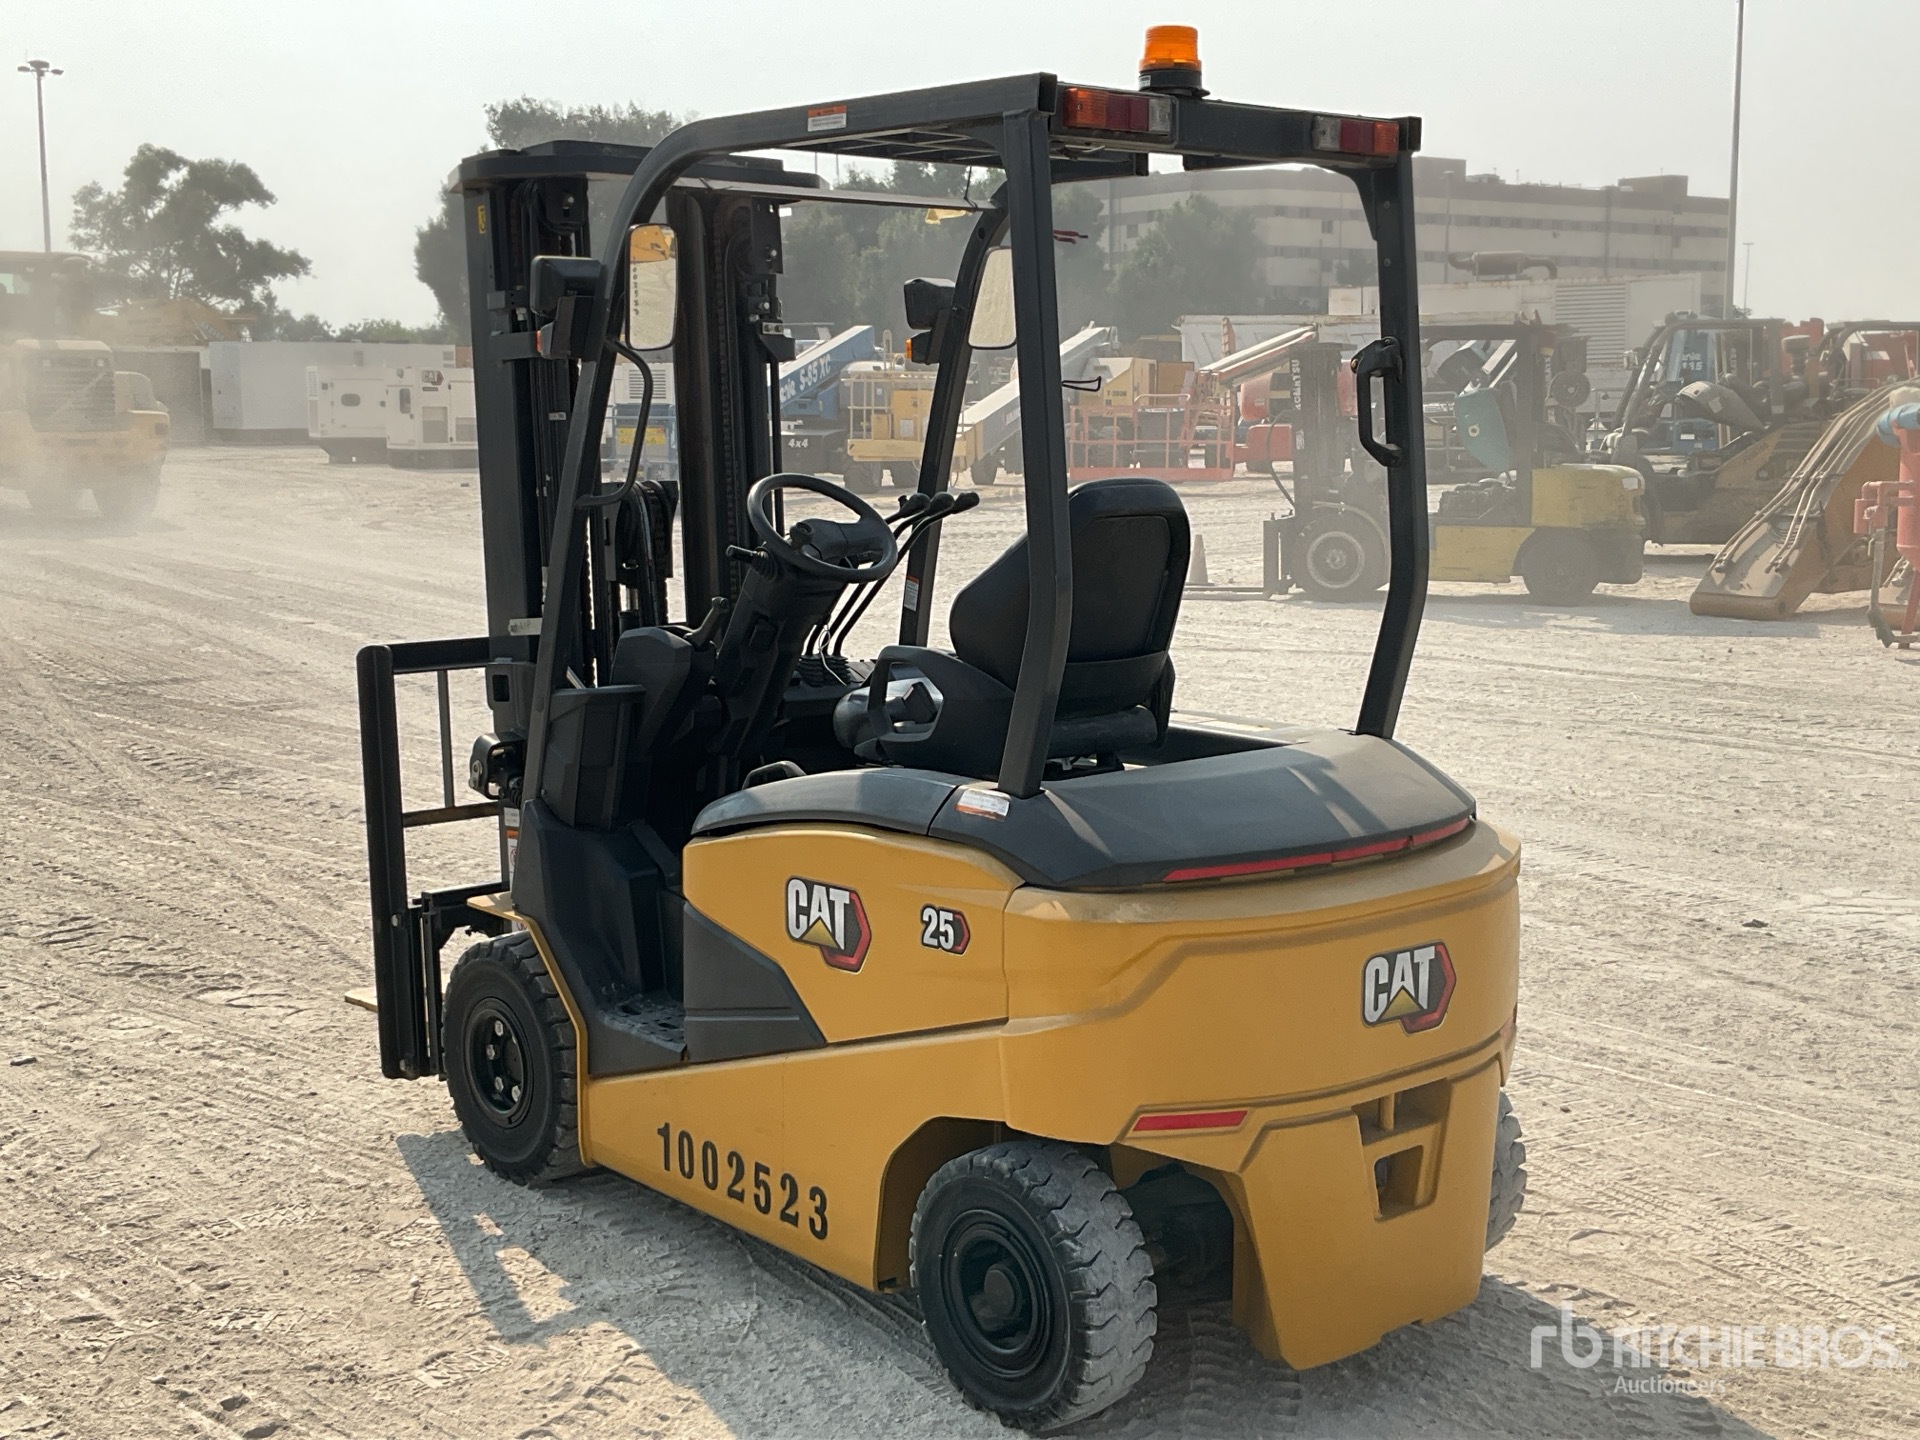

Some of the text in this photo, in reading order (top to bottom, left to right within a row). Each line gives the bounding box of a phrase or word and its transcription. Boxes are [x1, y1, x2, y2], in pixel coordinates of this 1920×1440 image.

[819, 353, 832, 379] XC
[787, 438, 809, 448] 4x4
[787, 877, 955, 951] CAT 25
[1363, 944, 1437, 1023] CAT
[656, 1121, 829, 1241] 1002523
